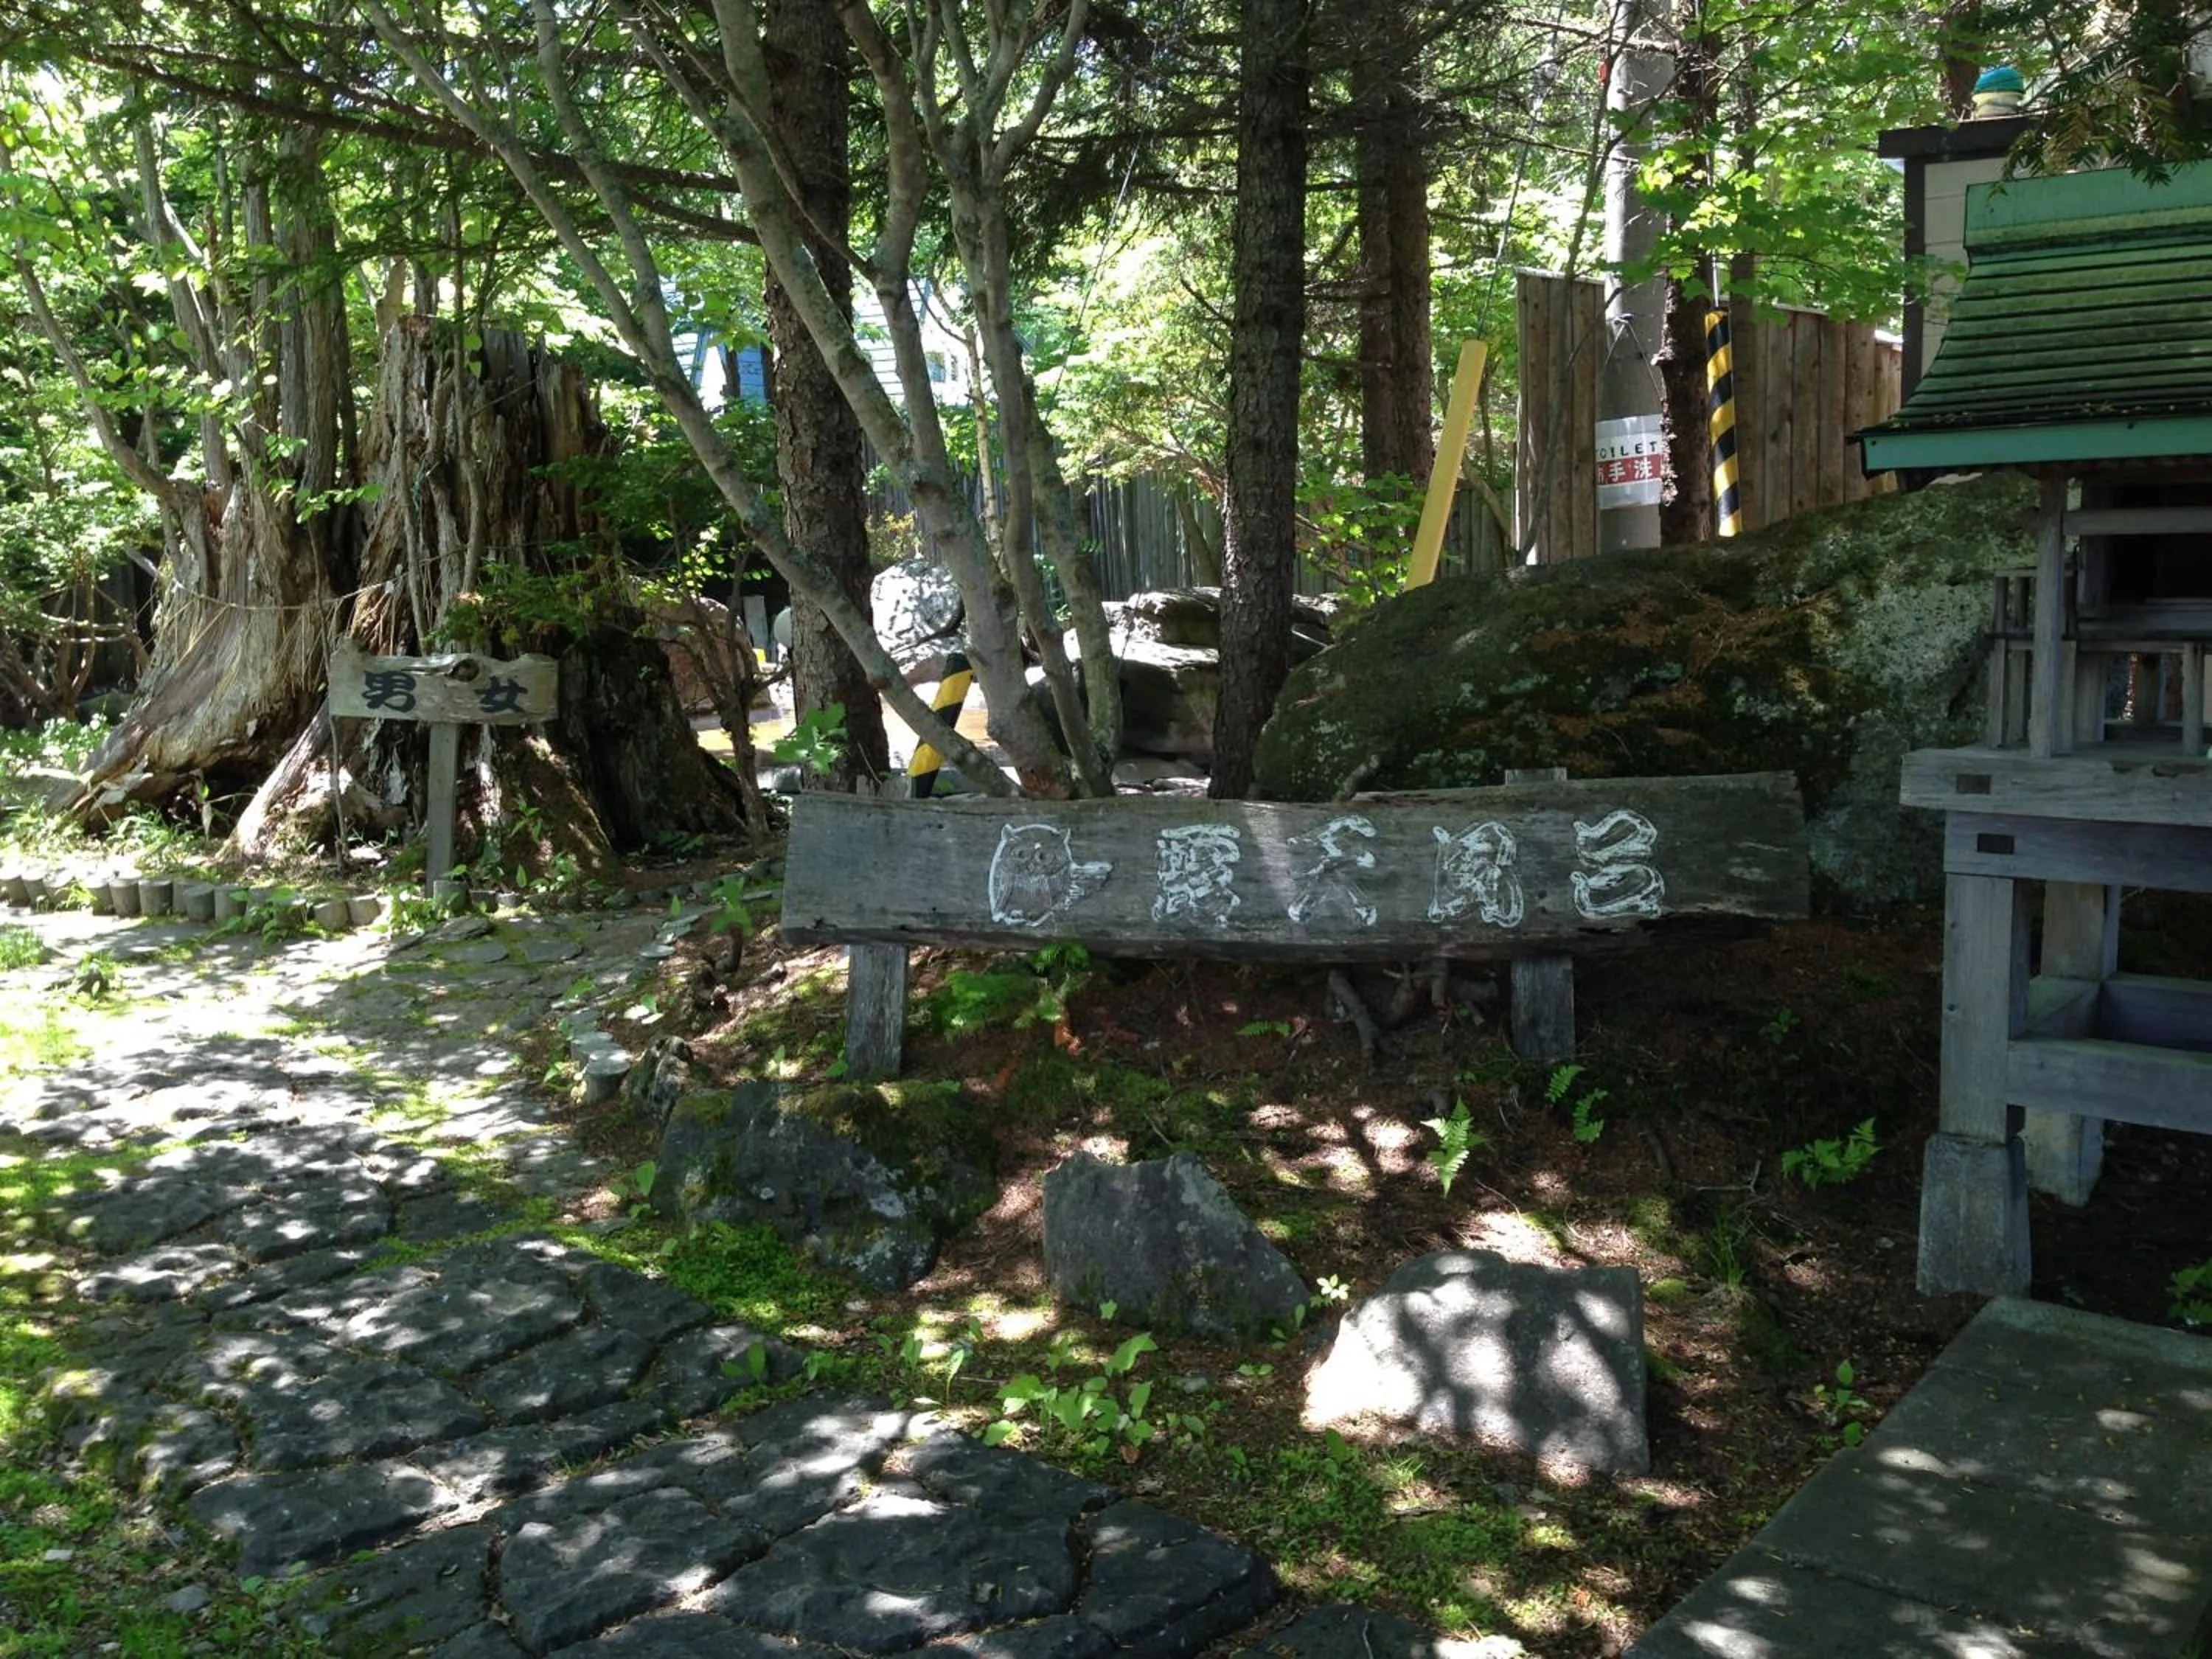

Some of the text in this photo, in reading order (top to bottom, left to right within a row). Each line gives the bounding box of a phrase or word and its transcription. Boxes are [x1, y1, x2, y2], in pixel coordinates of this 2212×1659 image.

[1596, 441, 1658, 459] OILET
[361, 670, 529, 713] 男 女
[1151, 810, 1665, 927] 露天風呂
